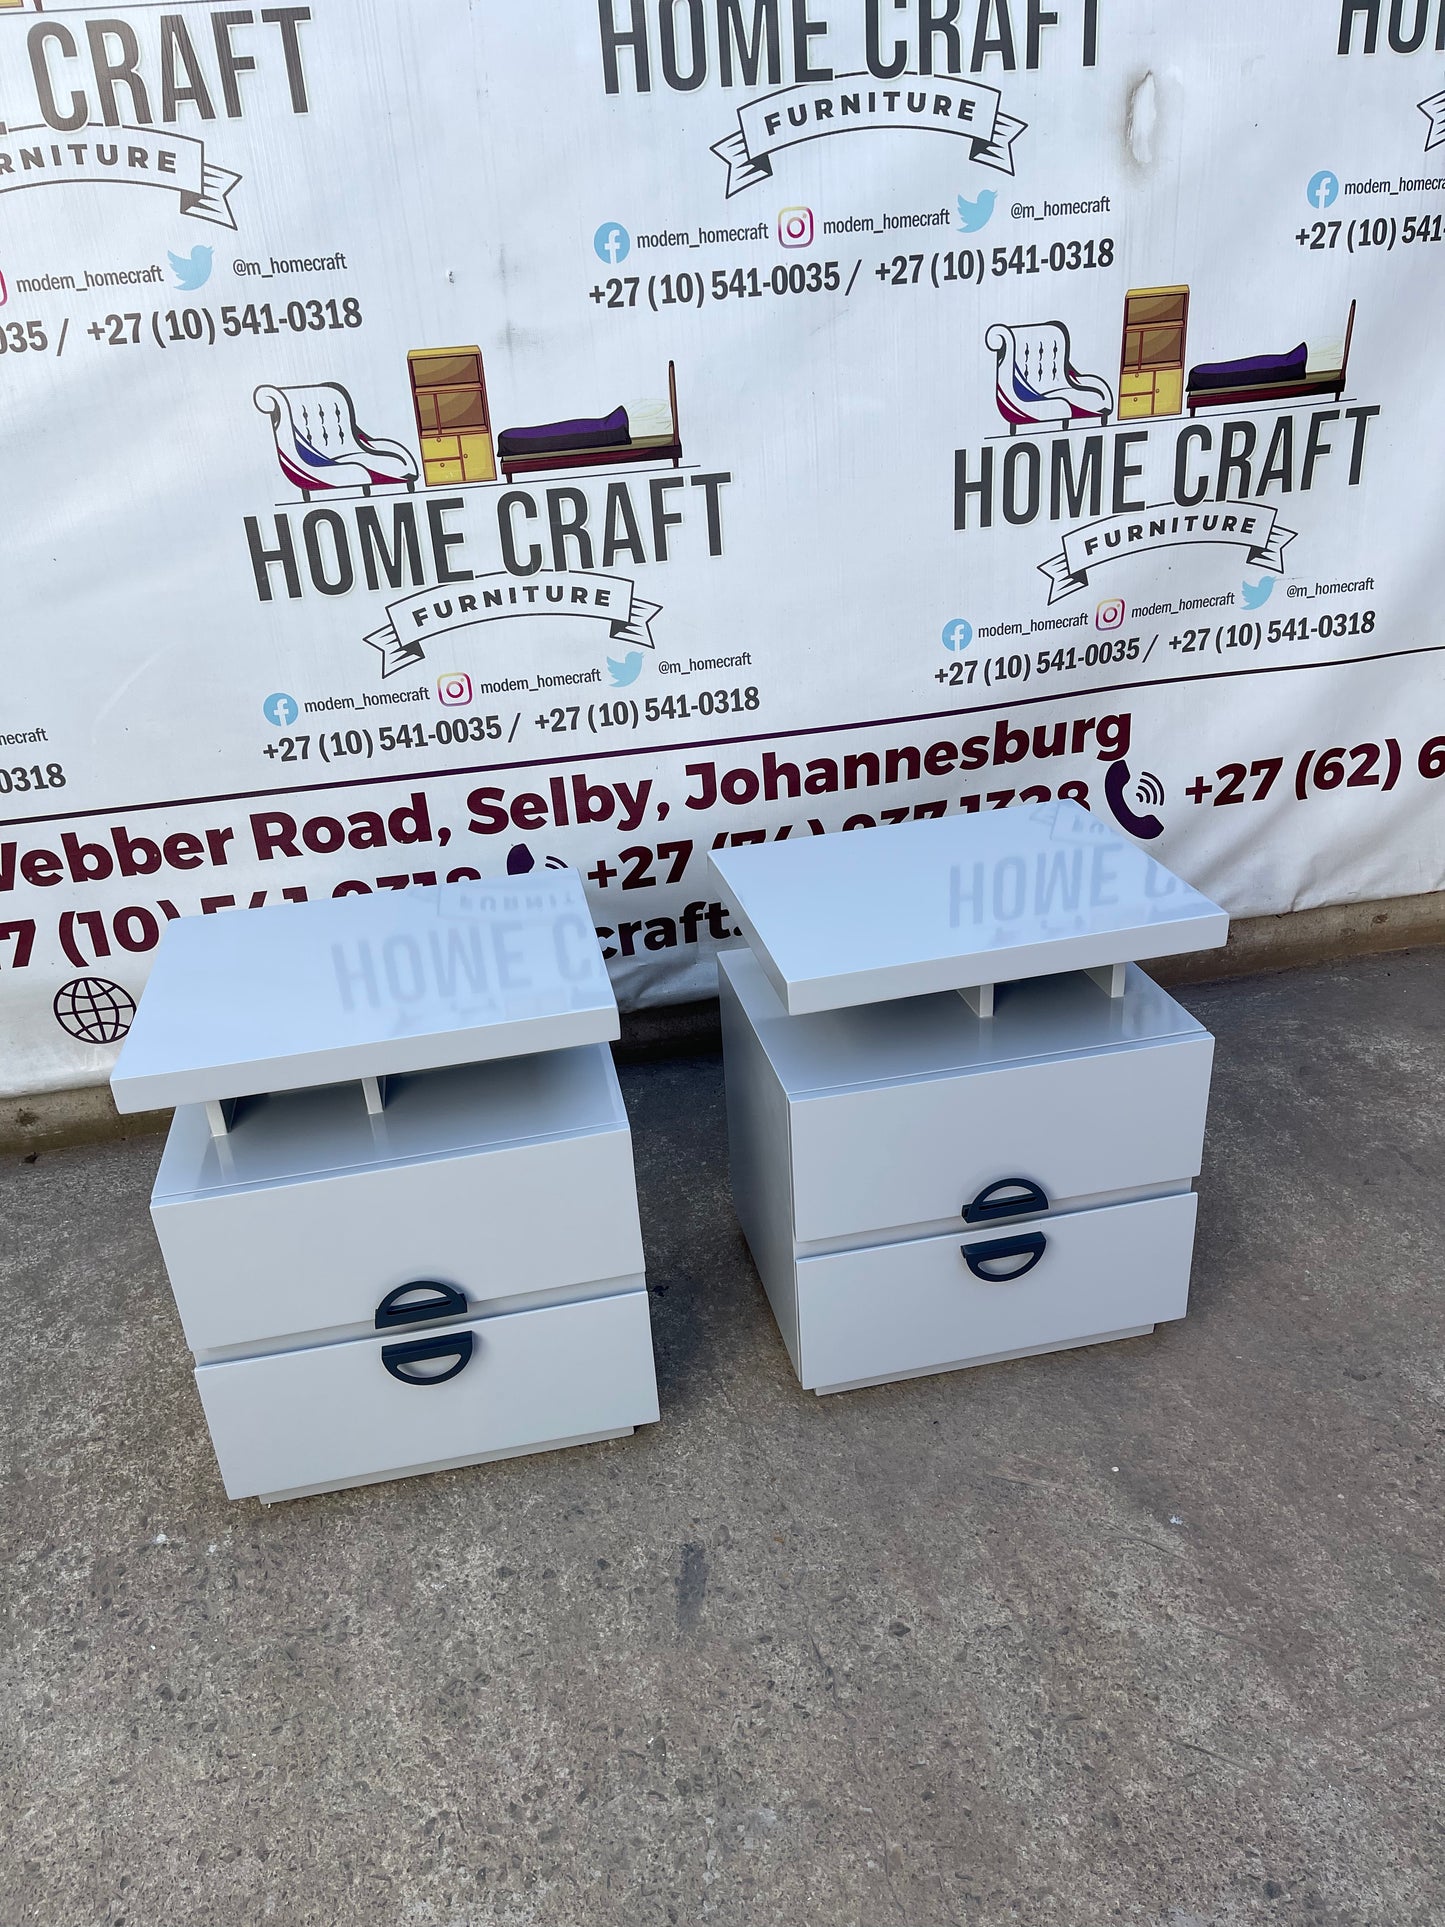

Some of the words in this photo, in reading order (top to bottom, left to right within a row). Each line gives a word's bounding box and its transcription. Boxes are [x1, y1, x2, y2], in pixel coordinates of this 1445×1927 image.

[598, 0, 834, 94] HOME
[1337, 0, 1445, 55] HO
[27, 7, 312, 131] CRAFT
[763, 91, 976, 136] FURNITURE
[1010, 195, 1111, 221] @m_homecraft
[1295, 220, 1342, 250] +27
[1347, 217, 1397, 253] (10)
[1401, 214, 1445, 245] 541
[233, 252, 348, 279] @m_homecraft
[589, 276, 640, 308] +27
[648, 271, 705, 311] (10)
[711, 261, 841, 300] 541-0035
[875, 254, 924, 286] +27
[931, 249, 985, 288] (10)
[991, 238, 1115, 277] 541-0318
[87, 313, 143, 346] +27
[152, 307, 217, 349] (10)
[221, 297, 363, 338] 541-0318
[954, 430, 1149, 530] HOME
[1174, 405, 1381, 507] CRAFT
[243, 496, 475, 601] HOME
[496, 472, 732, 576] CRAFT
[1084, 515, 1257, 555] FURNITURE
[412, 585, 612, 627] FURNITURE
[1286, 577, 1375, 599] @m_homecraft
[658, 652, 752, 675] @m_homecraft
[934, 660, 979, 686] +27
[984, 653, 1031, 687] (10)
[1036, 637, 1141, 674] 541-0035
[1168, 628, 1211, 653] +27
[1215, 622, 1262, 654] (10)
[1267, 610, 1376, 644] 541-0318
[263, 735, 311, 762] +27
[318, 728, 374, 763] (10)
[379, 714, 503, 751] 541-0035
[535, 706, 581, 733] +27
[587, 700, 639, 733] (10)
[645, 686, 760, 722] 541-0318
[249, 791, 453, 861] Road,
[466, 773, 671, 835] Selby,
[684, 712, 1132, 810] Johannesburg
[1185, 756, 1284, 807] +27
[1295, 738, 1402, 801] (62)
[587, 839, 694, 891] +27
[0, 918, 36, 969] 7
